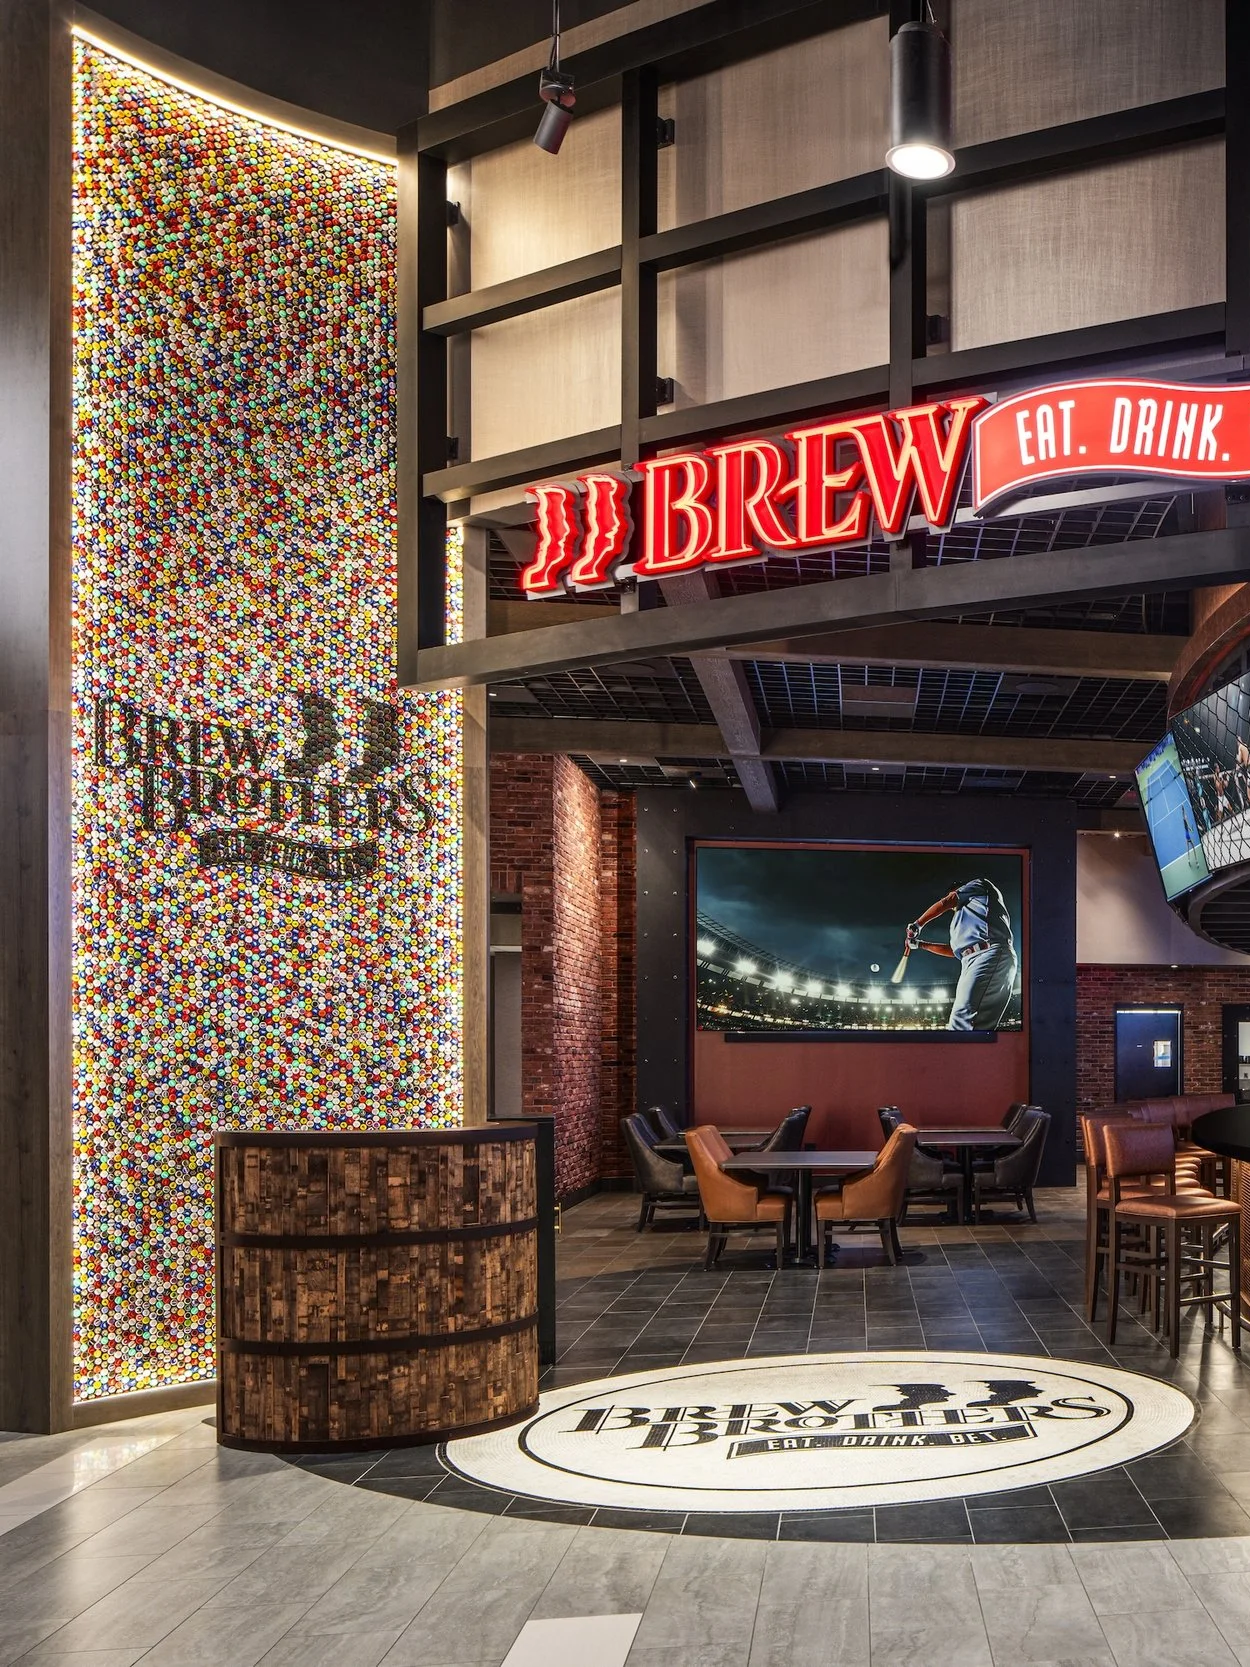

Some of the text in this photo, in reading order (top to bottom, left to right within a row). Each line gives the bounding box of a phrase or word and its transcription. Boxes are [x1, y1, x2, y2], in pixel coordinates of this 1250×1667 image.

[1015, 400, 1087, 467] EAT.
[1110, 396, 1230, 462] DRINK.
[633, 396, 989, 576] BREW
[558, 1397, 866, 1434] BREW
[625, 1396, 1111, 1451] BROTHERS
[767, 1431, 1007, 1450] EAT. DRINK. BET.
